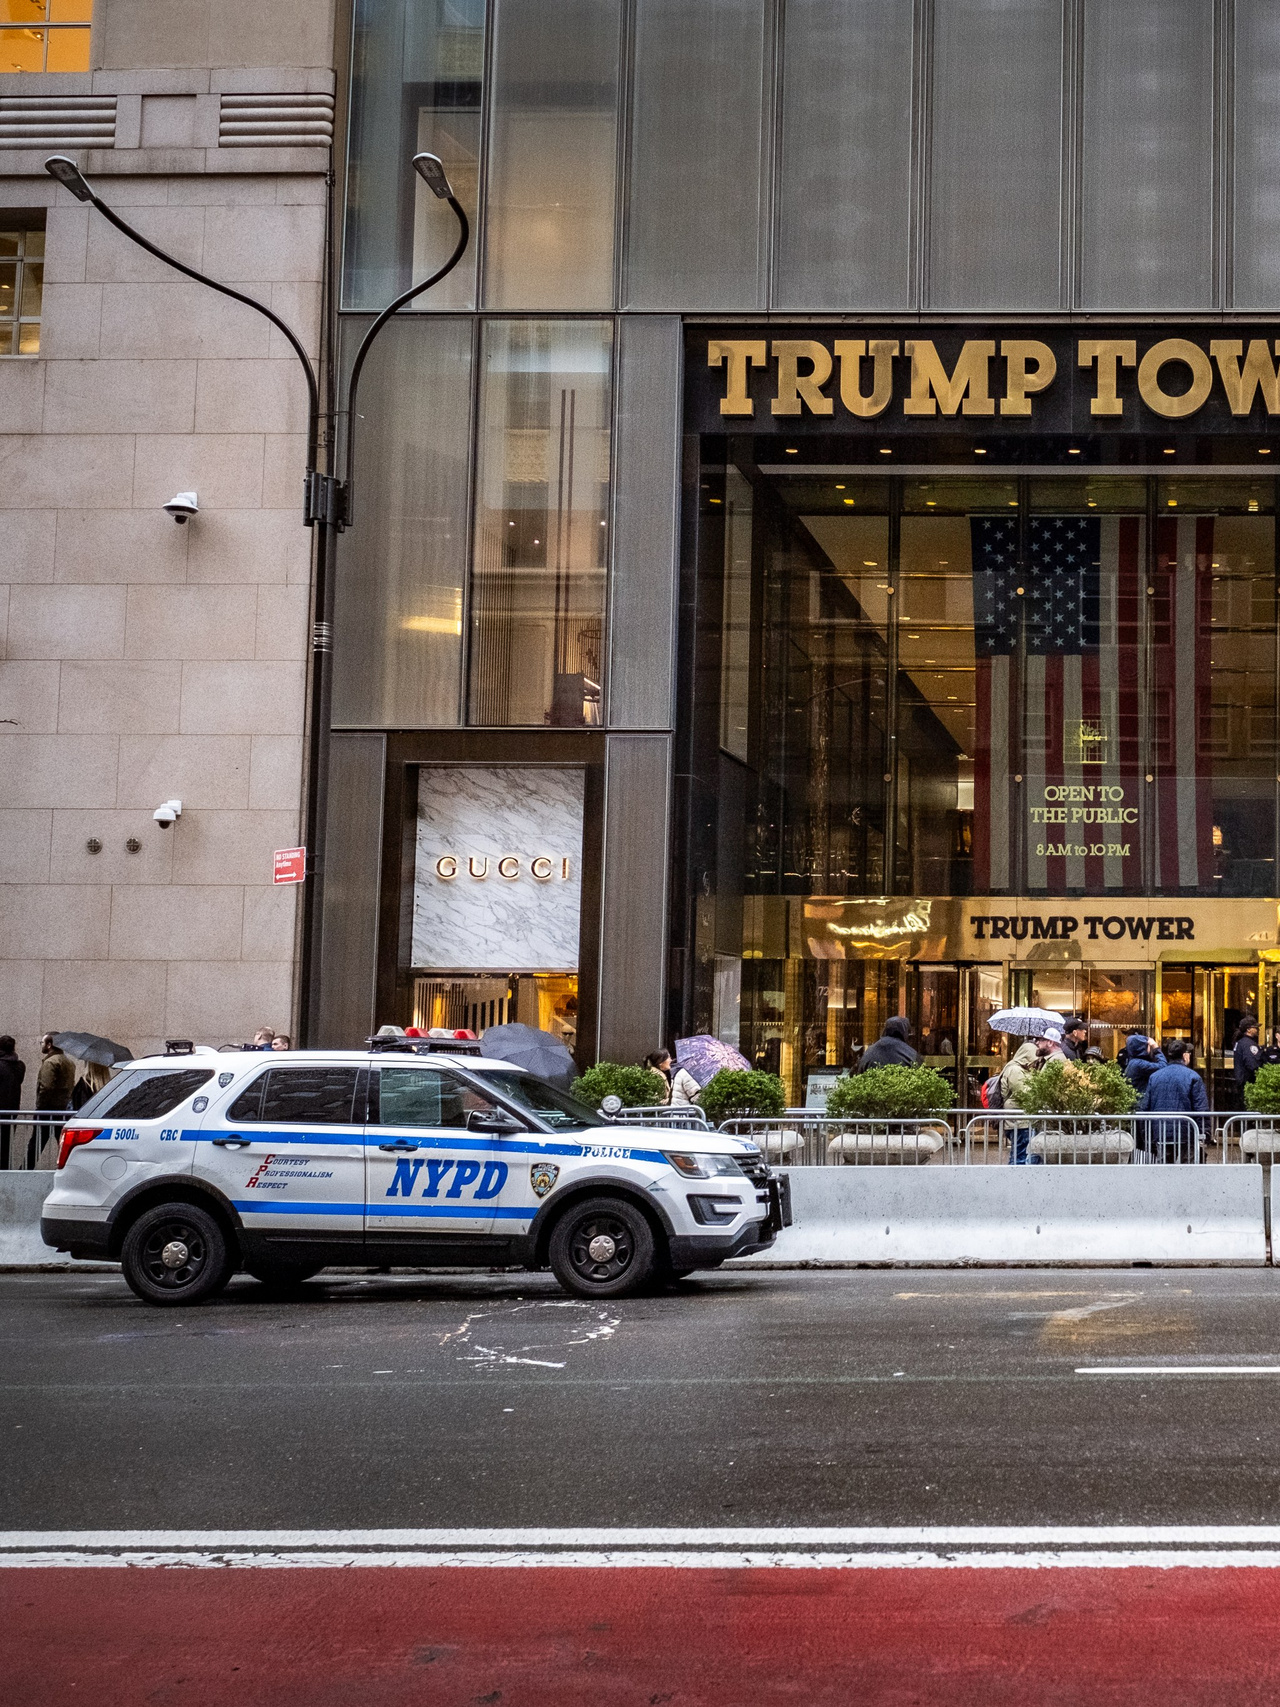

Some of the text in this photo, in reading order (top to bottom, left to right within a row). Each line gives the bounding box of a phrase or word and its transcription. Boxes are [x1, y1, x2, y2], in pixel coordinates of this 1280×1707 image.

[708, 338, 1057, 418] TRUMP
[1044, 785, 1124, 801] OPEN TO
[1030, 807, 1138, 823] THE PUBLIC
[1036, 844, 1130, 856] 8 AM to 10 PM
[436, 856, 568, 878] GUCCI
[970, 916, 1195, 940] TRUMP TOWER
[114, 1128, 136, 1140] 5001
[160, 1129, 178, 1141] CRC
[582, 1146, 630, 1159] POLICE
[264, 1154, 311, 1166] COURTESY
[255, 1165, 334, 1178] PROFESSIONALISM
[245, 1177, 288, 1189] RESPECT
[385, 1158, 509, 1200] NYPD
